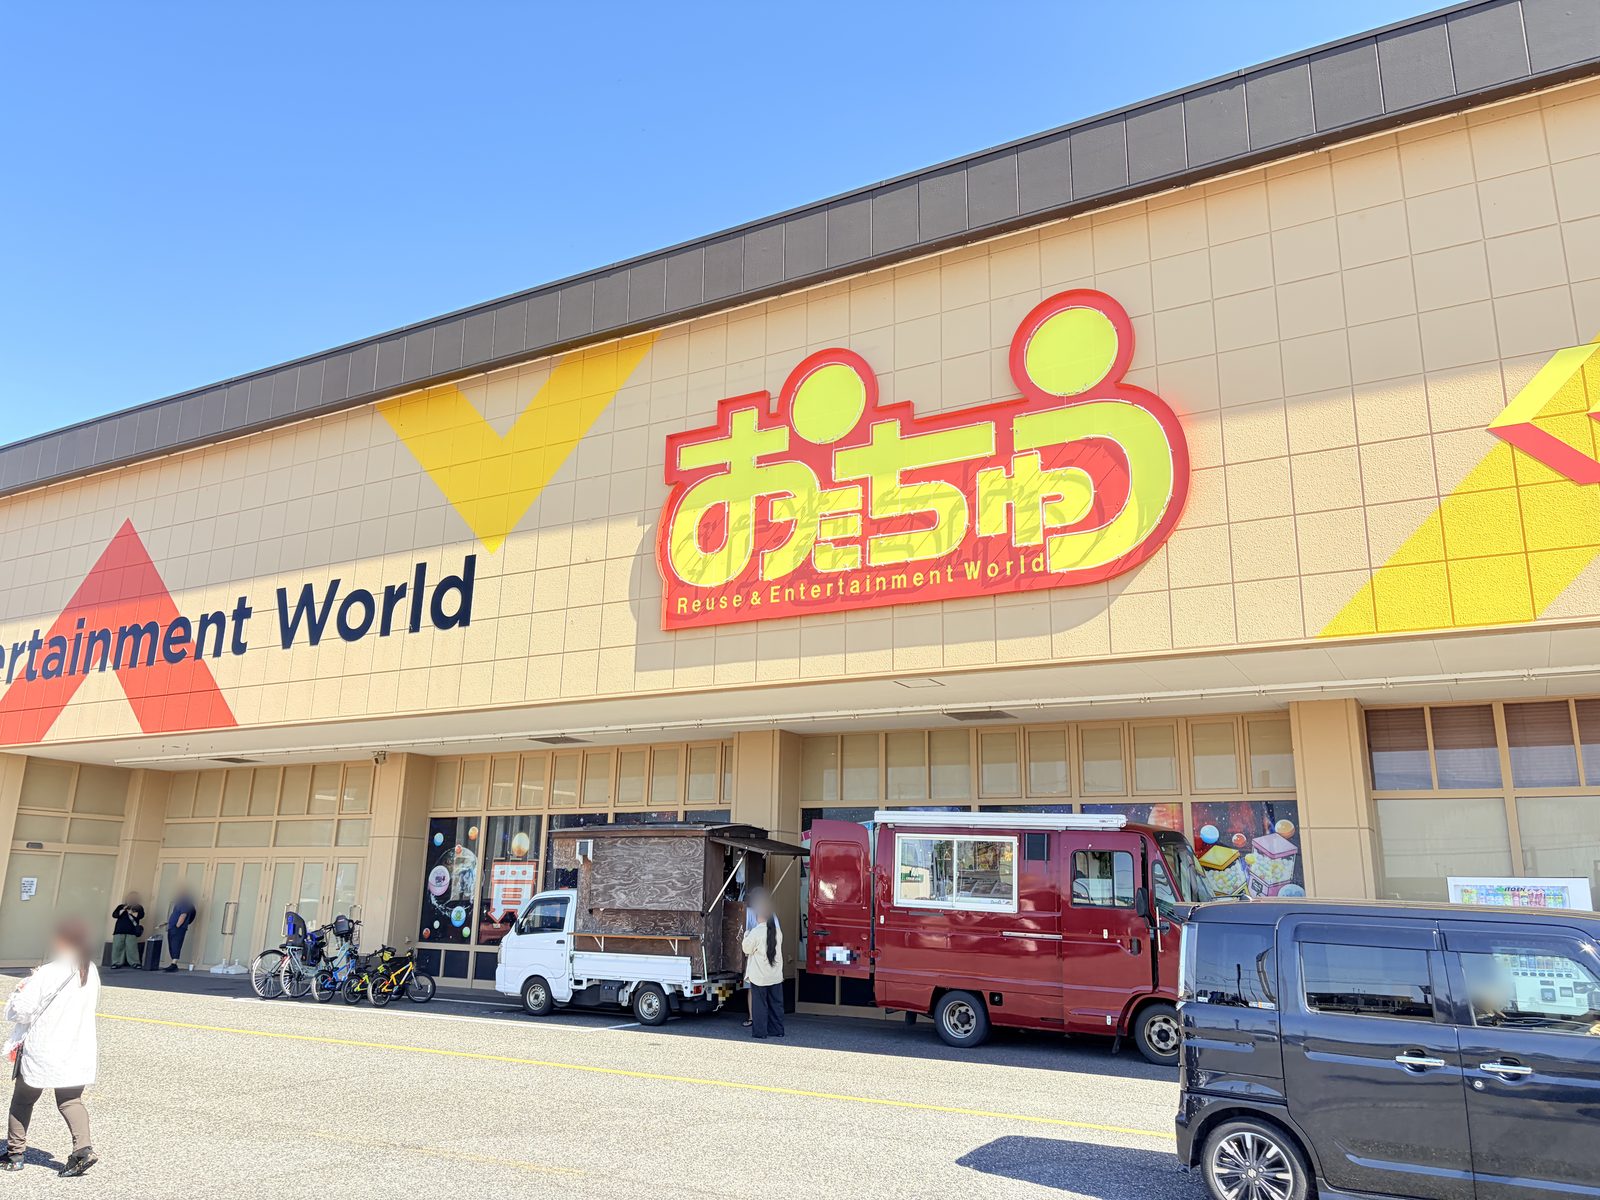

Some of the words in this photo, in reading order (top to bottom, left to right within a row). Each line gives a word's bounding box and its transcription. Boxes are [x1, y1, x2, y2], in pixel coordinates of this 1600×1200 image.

[0, 596, 252, 684] rtainment
[277, 555, 476, 649] World
[677, 589, 742, 614] Reuse
[750, 590, 762, 607] &
[769, 567, 955, 603] Entertainment
[964, 552, 1045, 579] World
